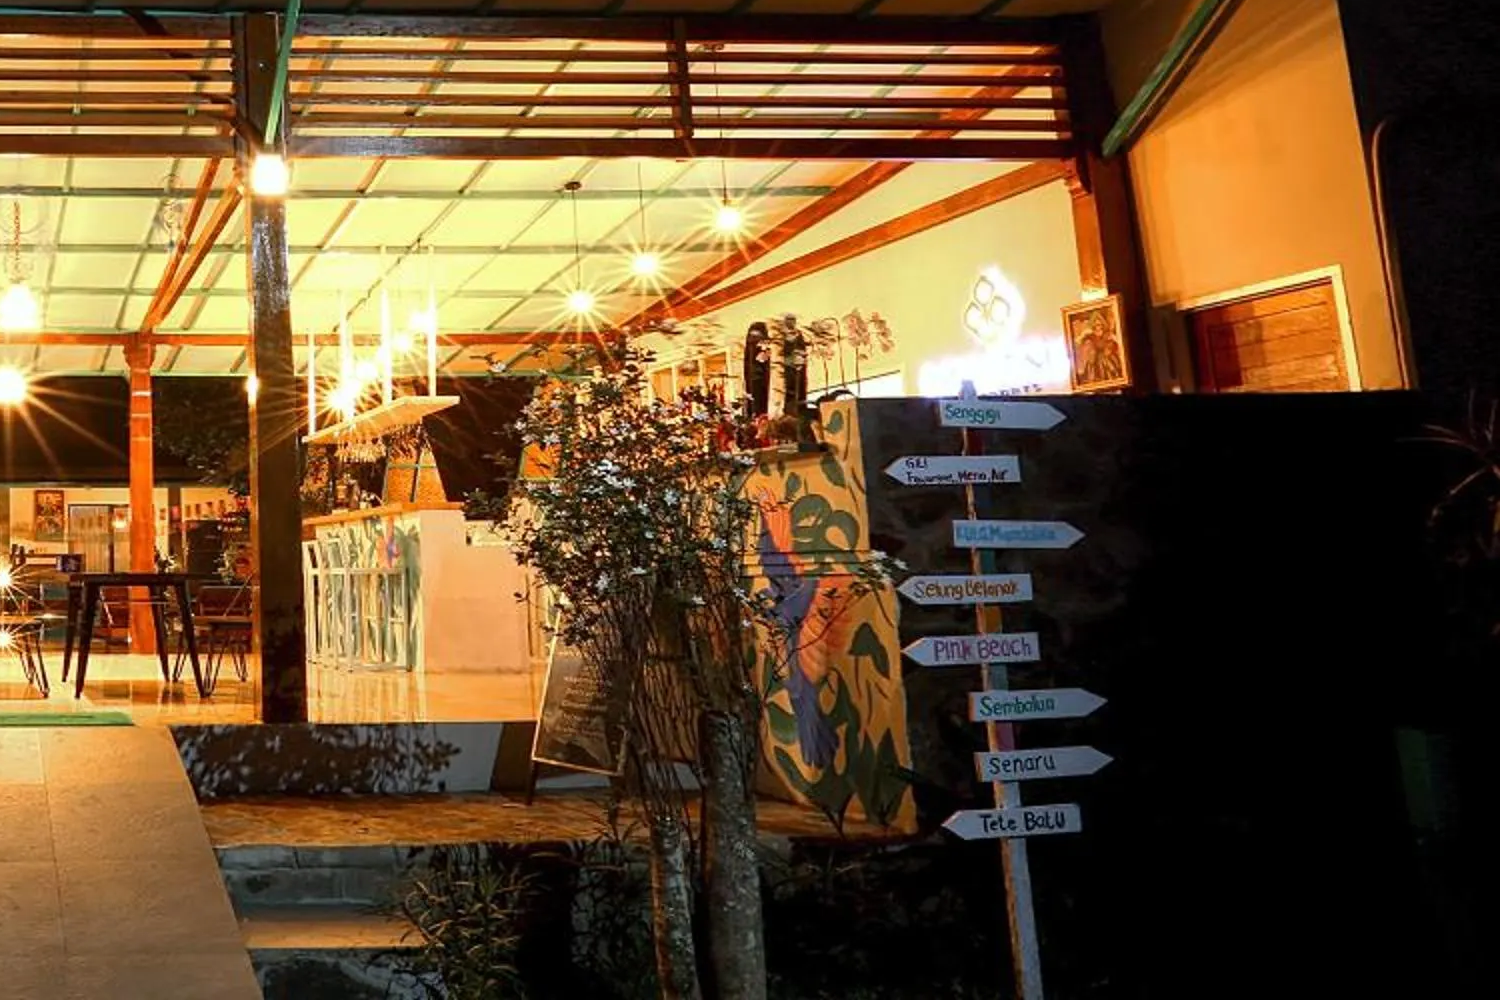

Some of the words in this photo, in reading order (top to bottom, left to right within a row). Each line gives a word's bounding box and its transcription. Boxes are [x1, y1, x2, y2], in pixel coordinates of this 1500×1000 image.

[977, 637, 1031, 659] Beach
[989, 755, 1056, 774] Senaru
[978, 813, 1017, 833] Tete
